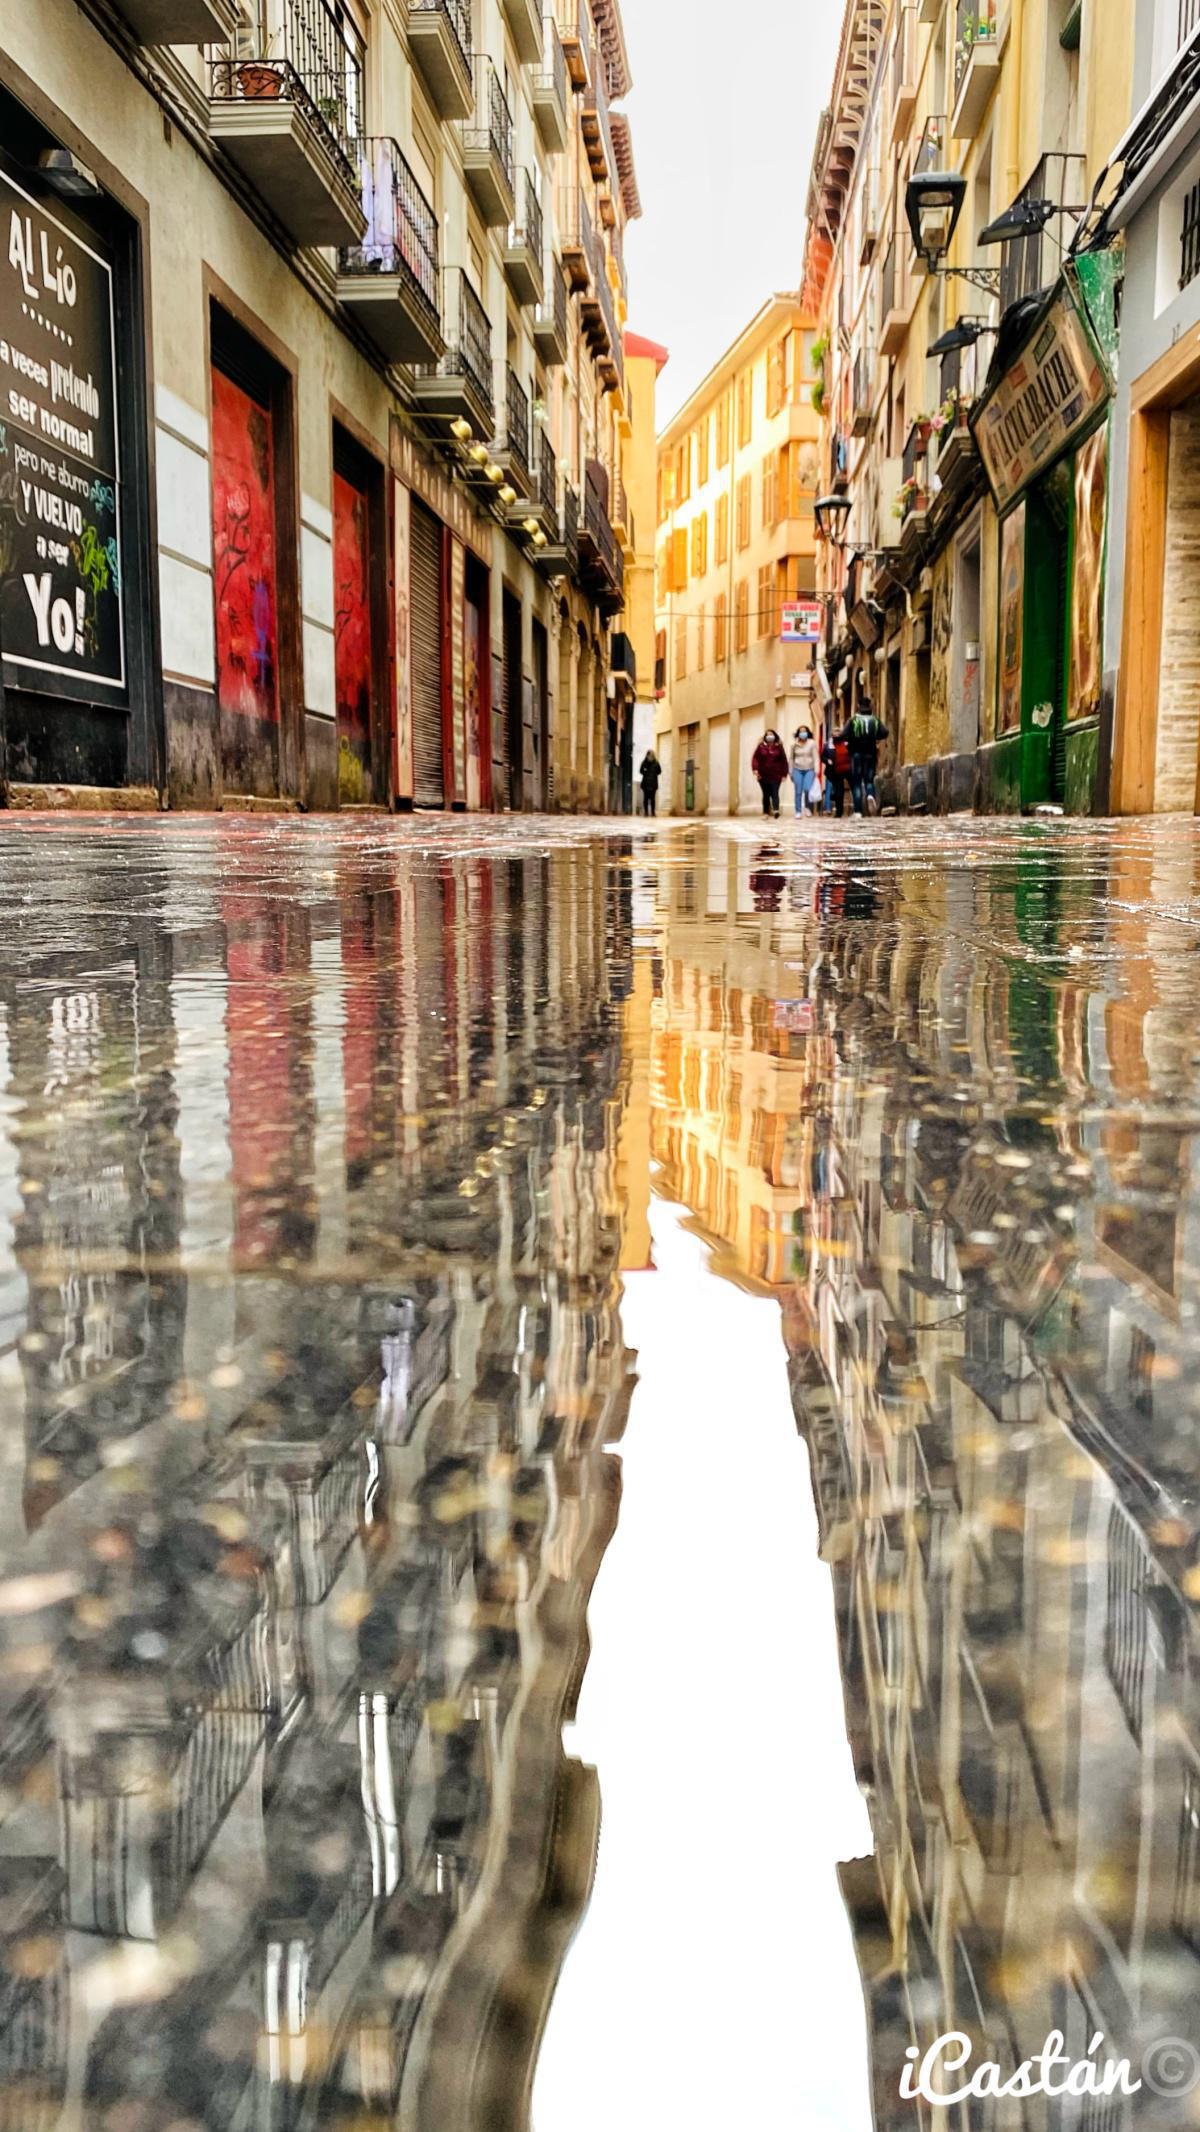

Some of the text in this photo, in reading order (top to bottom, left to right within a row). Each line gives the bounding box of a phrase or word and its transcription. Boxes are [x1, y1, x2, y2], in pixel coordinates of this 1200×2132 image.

[0, 339, 100, 420] a veces pretendo
[1003, 343, 1078, 450] CUCARACHA
[8, 389, 37, 425] ser
[40, 407, 94, 458] normal
[14, 443, 39, 474] pero
[40, 456, 57, 481] me
[58, 459, 90, 498] aburro
[20, 479, 32, 514] Y
[33, 485, 83, 536] VUELVO
[48, 539, 70, 568] ser
[22, 572, 86, 657] Yo!
